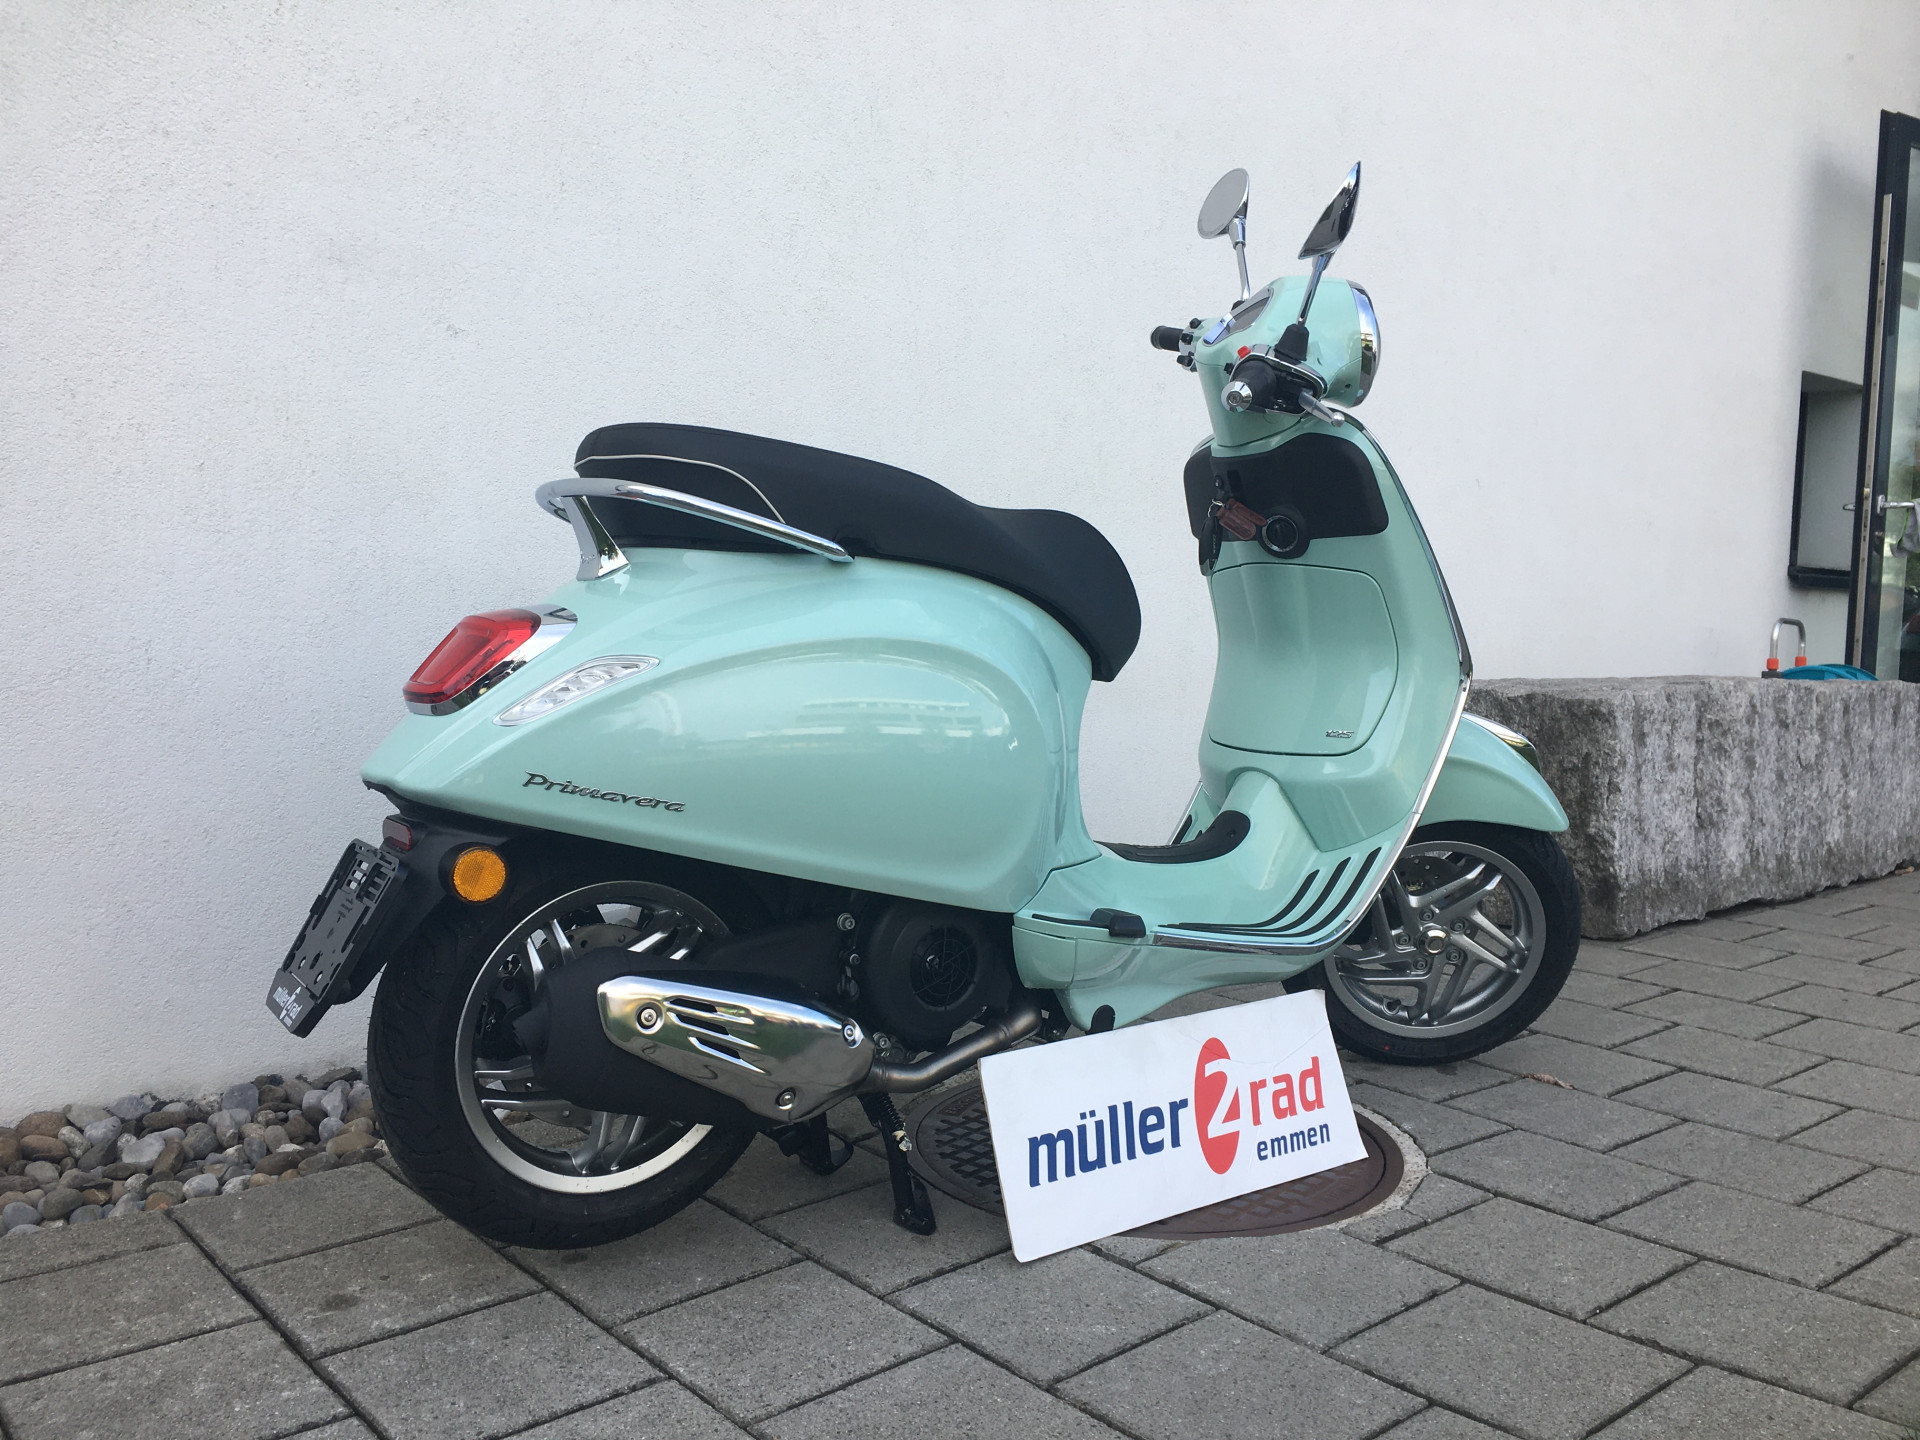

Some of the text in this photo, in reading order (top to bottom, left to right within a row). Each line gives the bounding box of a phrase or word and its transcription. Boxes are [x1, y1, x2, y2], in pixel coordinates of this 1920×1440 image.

[522, 770, 685, 812] Primavera
[1027, 1098, 1189, 1188] müller
[1256, 1122, 1331, 1162] emmen
